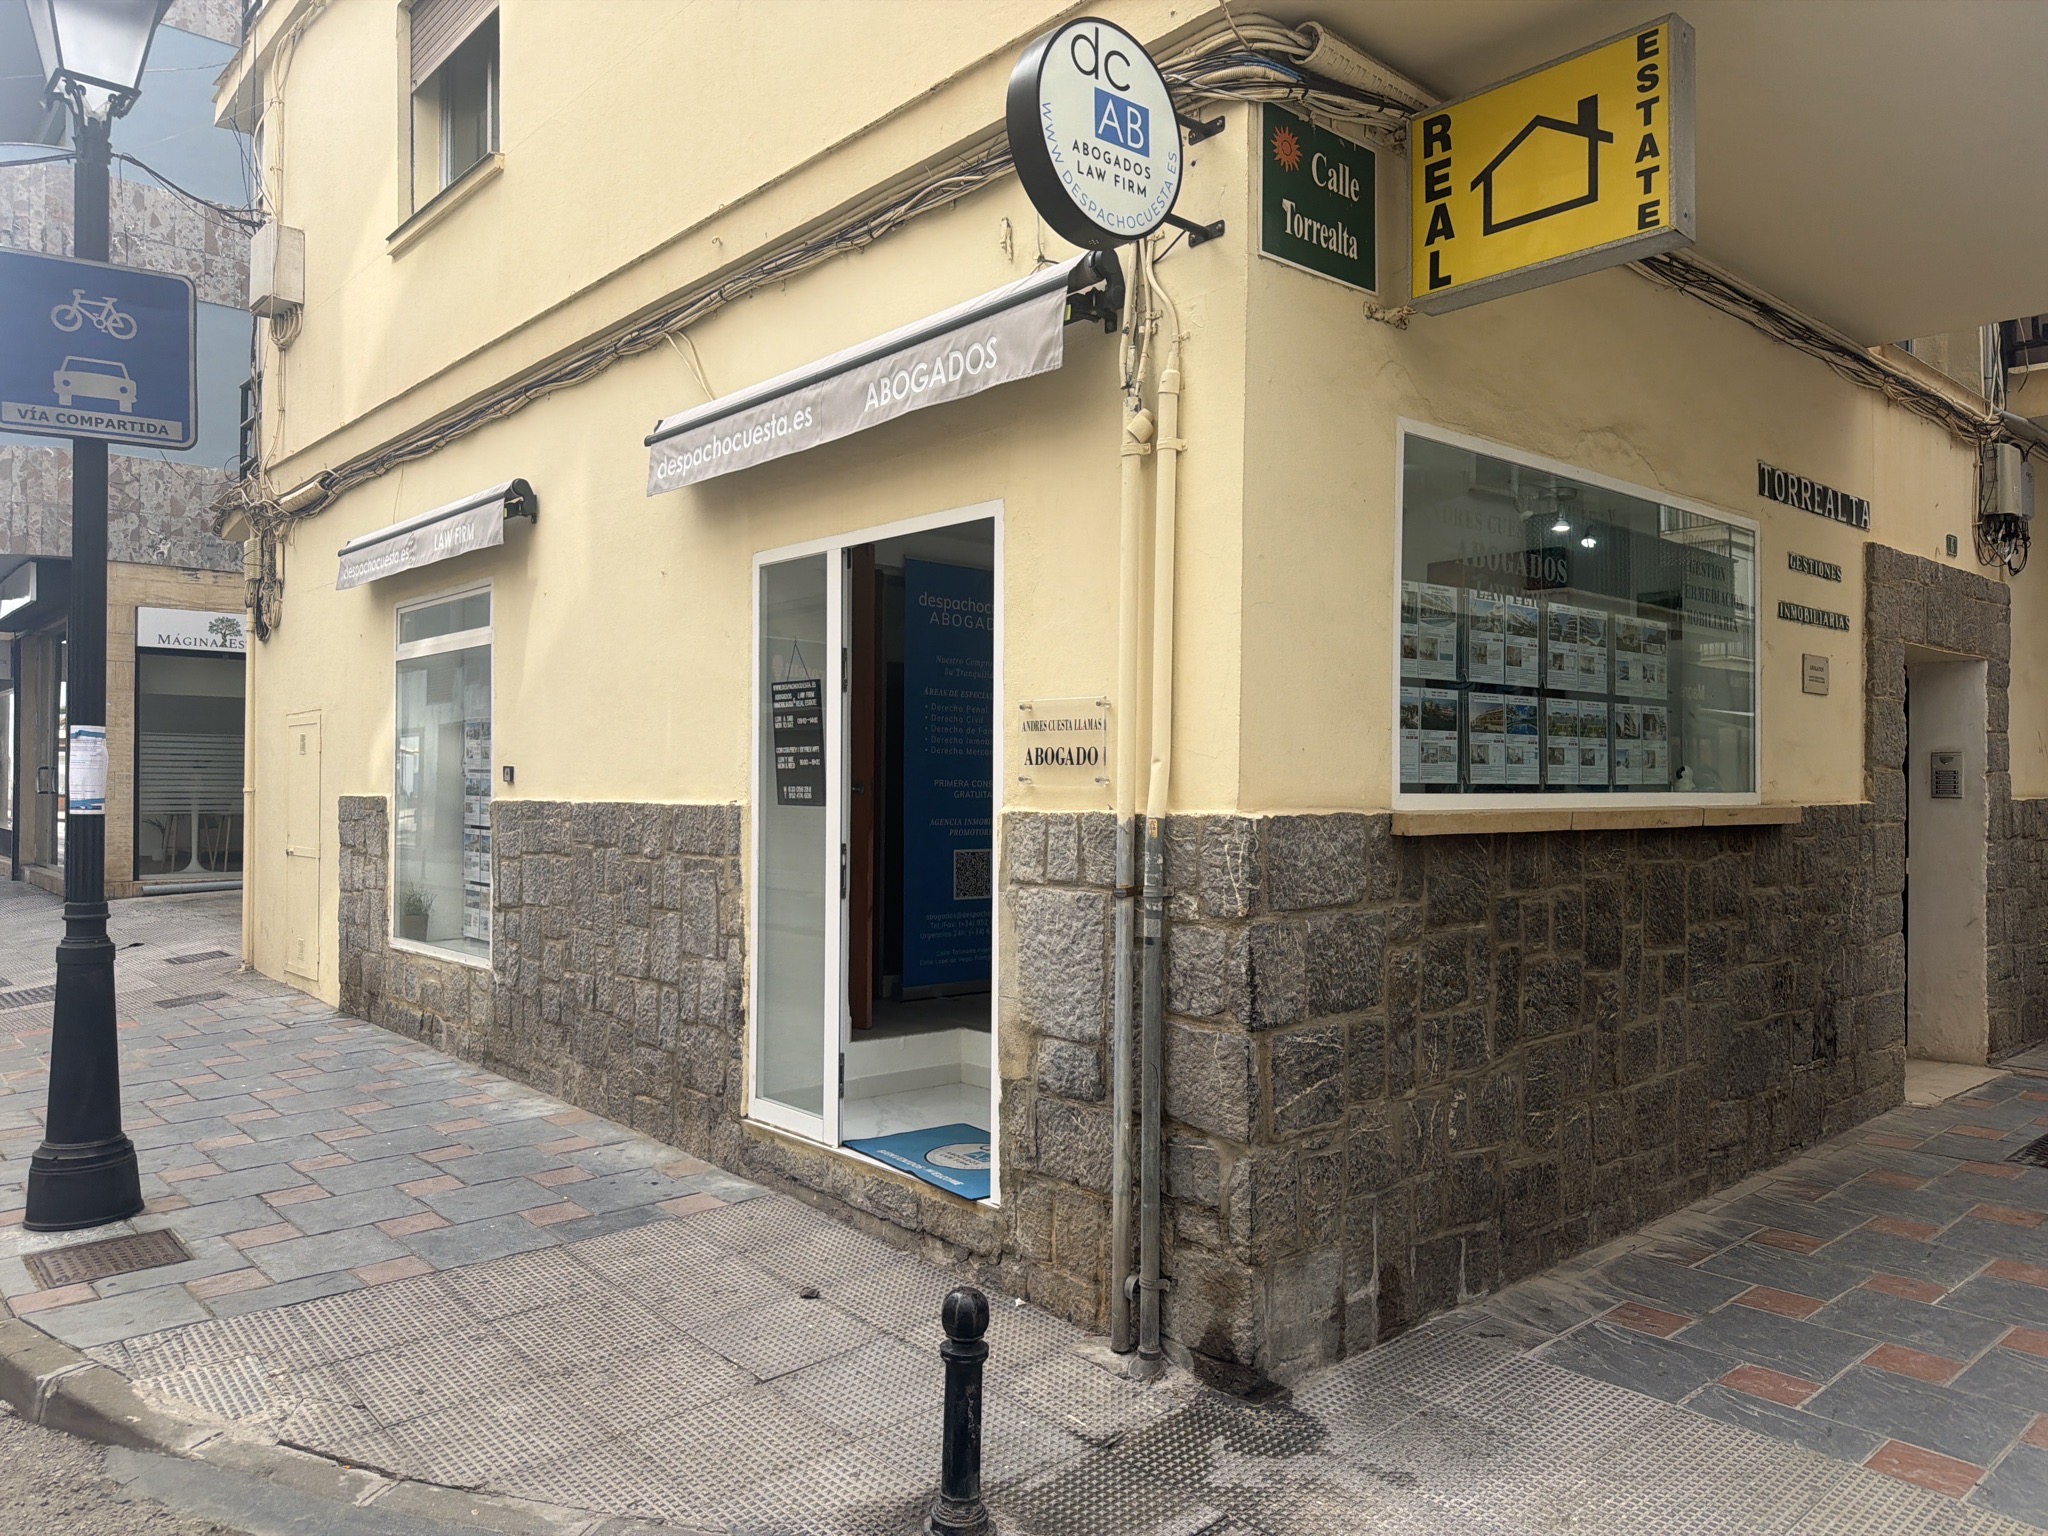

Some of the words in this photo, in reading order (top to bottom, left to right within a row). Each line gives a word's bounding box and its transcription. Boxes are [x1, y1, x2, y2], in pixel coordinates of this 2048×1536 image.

[1098, 98, 1145, 149] AB
[1634, 28, 1661, 231] ESTATE
[1072, 139, 1152, 180] ABOGADOS
[1077, 159, 1107, 182] LAW
[1114, 174, 1147, 198] FIRM
[1310, 151, 1361, 203] Calle
[1422, 113, 1455, 291] REAL
[1282, 198, 1359, 261] Torrealta
[657, 404, 814, 480] despachocuesta.es
[864, 335, 998, 413] ABOGADOS
[17, 407, 50, 422] VÍA
[55, 412, 170, 436] COMPARTIDA
[1760, 463, 1871, 530] TORREALTA
[343, 546, 411, 580] despachocuesta.es
[434, 529, 454, 552] LAW
[454, 522, 475, 545] FIRM
[1455, 538, 1568, 584] ABOGADOS
[1788, 552, 1842, 581] GESTIONES
[918, 591, 994, 614] despachoc
[1778, 602, 1850, 631] INMOBILIARIAS
[157, 633, 219, 647] MÁGINA
[229, 638, 248, 649] ES
[936, 655, 964, 665] Nuestro
[948, 689, 959, 697] DE
[931, 702, 963, 713] Derecho
[966, 704, 988, 714] Penal
[931, 713, 963, 723] Derecho
[966, 715, 984, 724] Civil
[931, 724, 963, 734] Derecho
[966, 726, 976, 735] de
[1021, 719, 1048, 732] ANDRES
[1048, 718, 1073, 732] CUESTA
[1074, 717, 1103, 731] LLAMAS
[931, 735, 963, 745] Derecho
[931, 746, 963, 756] Derecho
[1024, 746, 1099, 766] ABOGADO
[934, 779, 970, 788] PRIMERA
[954, 790, 993, 799] GRATUITA
[929, 817, 962, 826] AGENCIA
